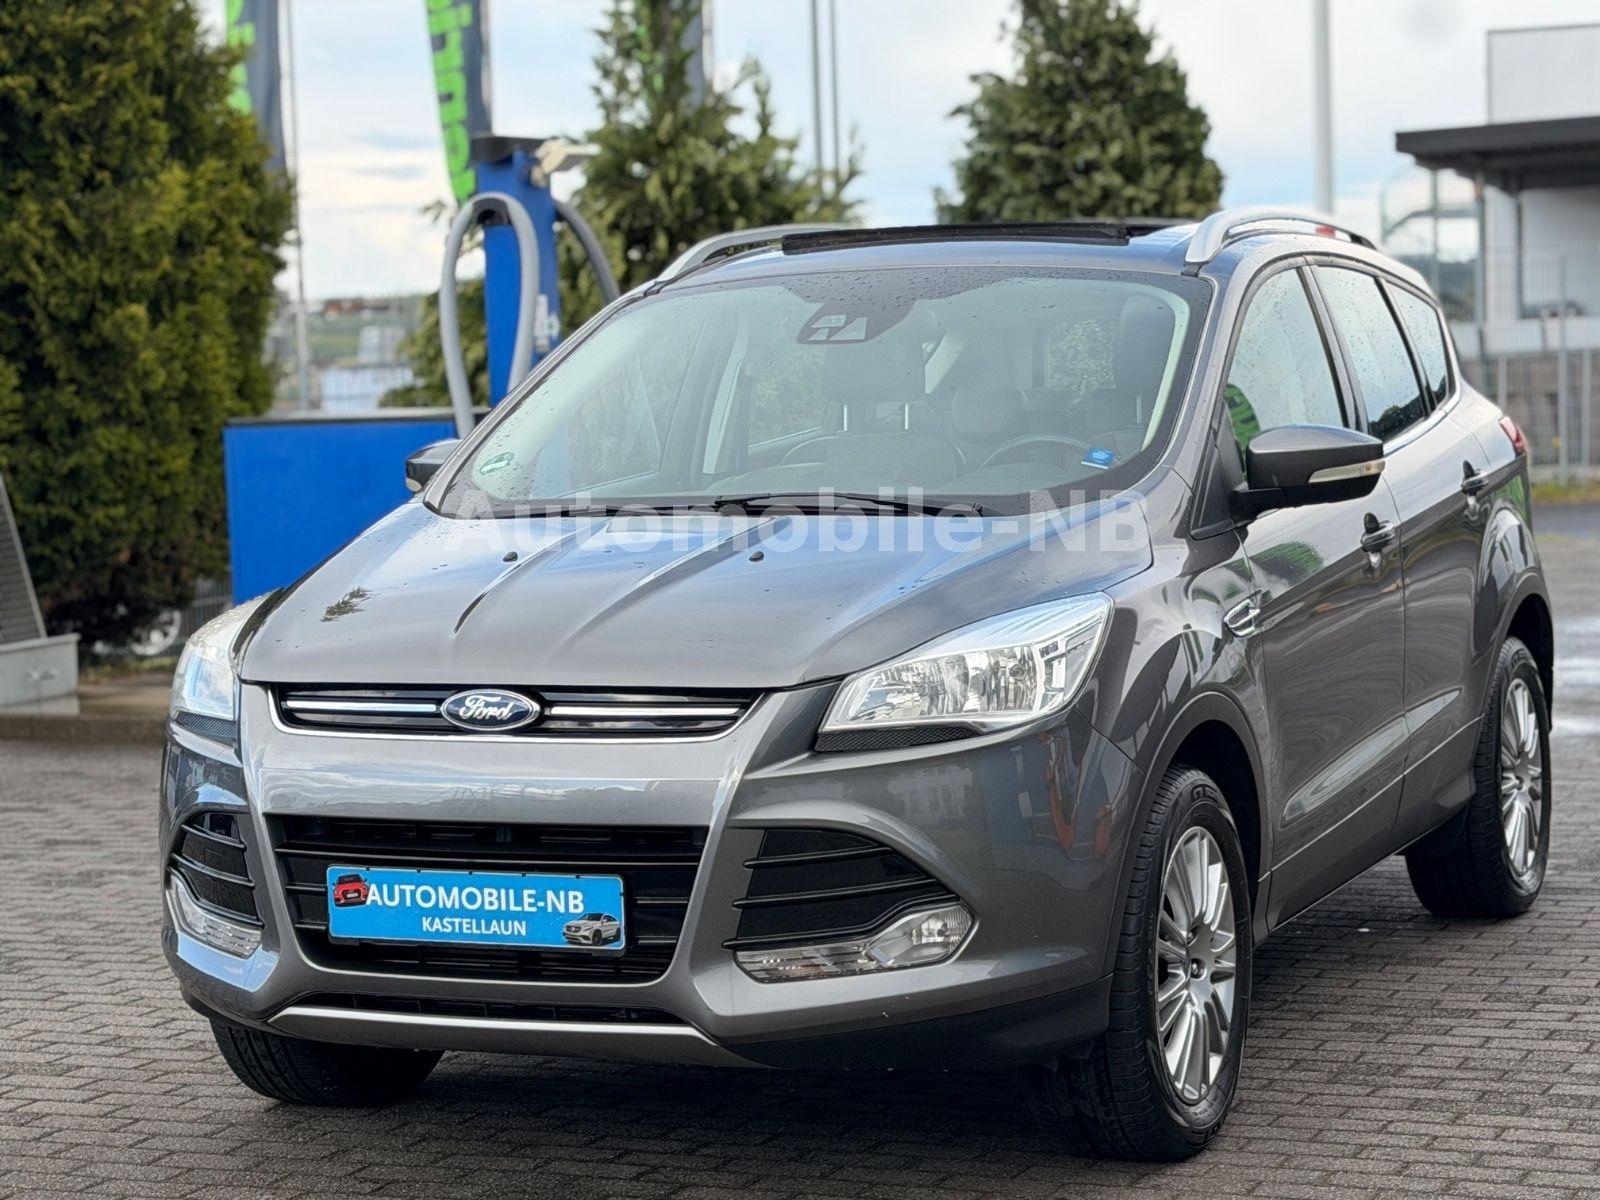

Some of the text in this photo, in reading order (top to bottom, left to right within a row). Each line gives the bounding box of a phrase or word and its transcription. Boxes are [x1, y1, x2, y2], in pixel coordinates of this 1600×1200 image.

[459, 695, 514, 720] Ford
[365, 883, 585, 913] AUTOMOBILE-NB
[421, 916, 527, 936] KASTELLAUN
